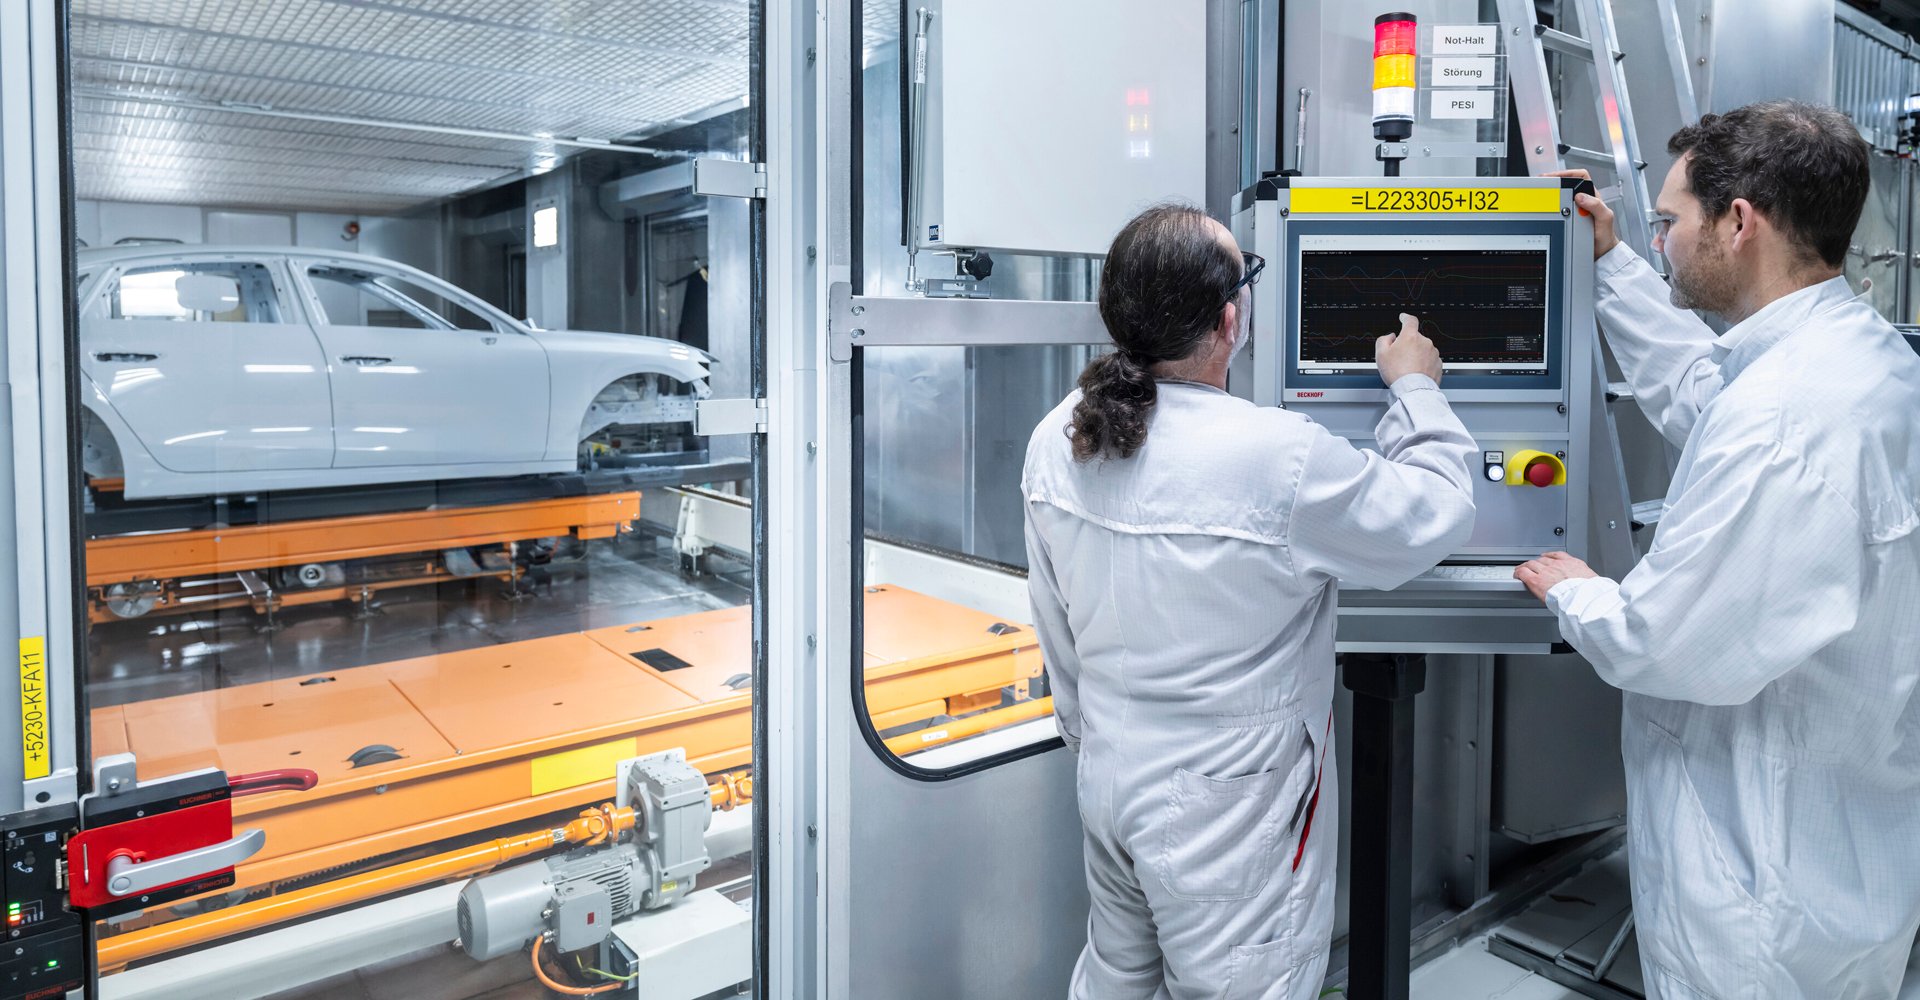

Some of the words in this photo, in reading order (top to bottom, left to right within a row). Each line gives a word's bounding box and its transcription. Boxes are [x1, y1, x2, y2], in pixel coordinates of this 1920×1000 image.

[1444, 36, 1485, 45] Not-Halt
[1443, 68, 1483, 78] Störung
[1451, 100, 1475, 109] PESI
[1351, 190, 1500, 211] =L223305+I32
[22, 652, 44, 761] +5230-KFA11
